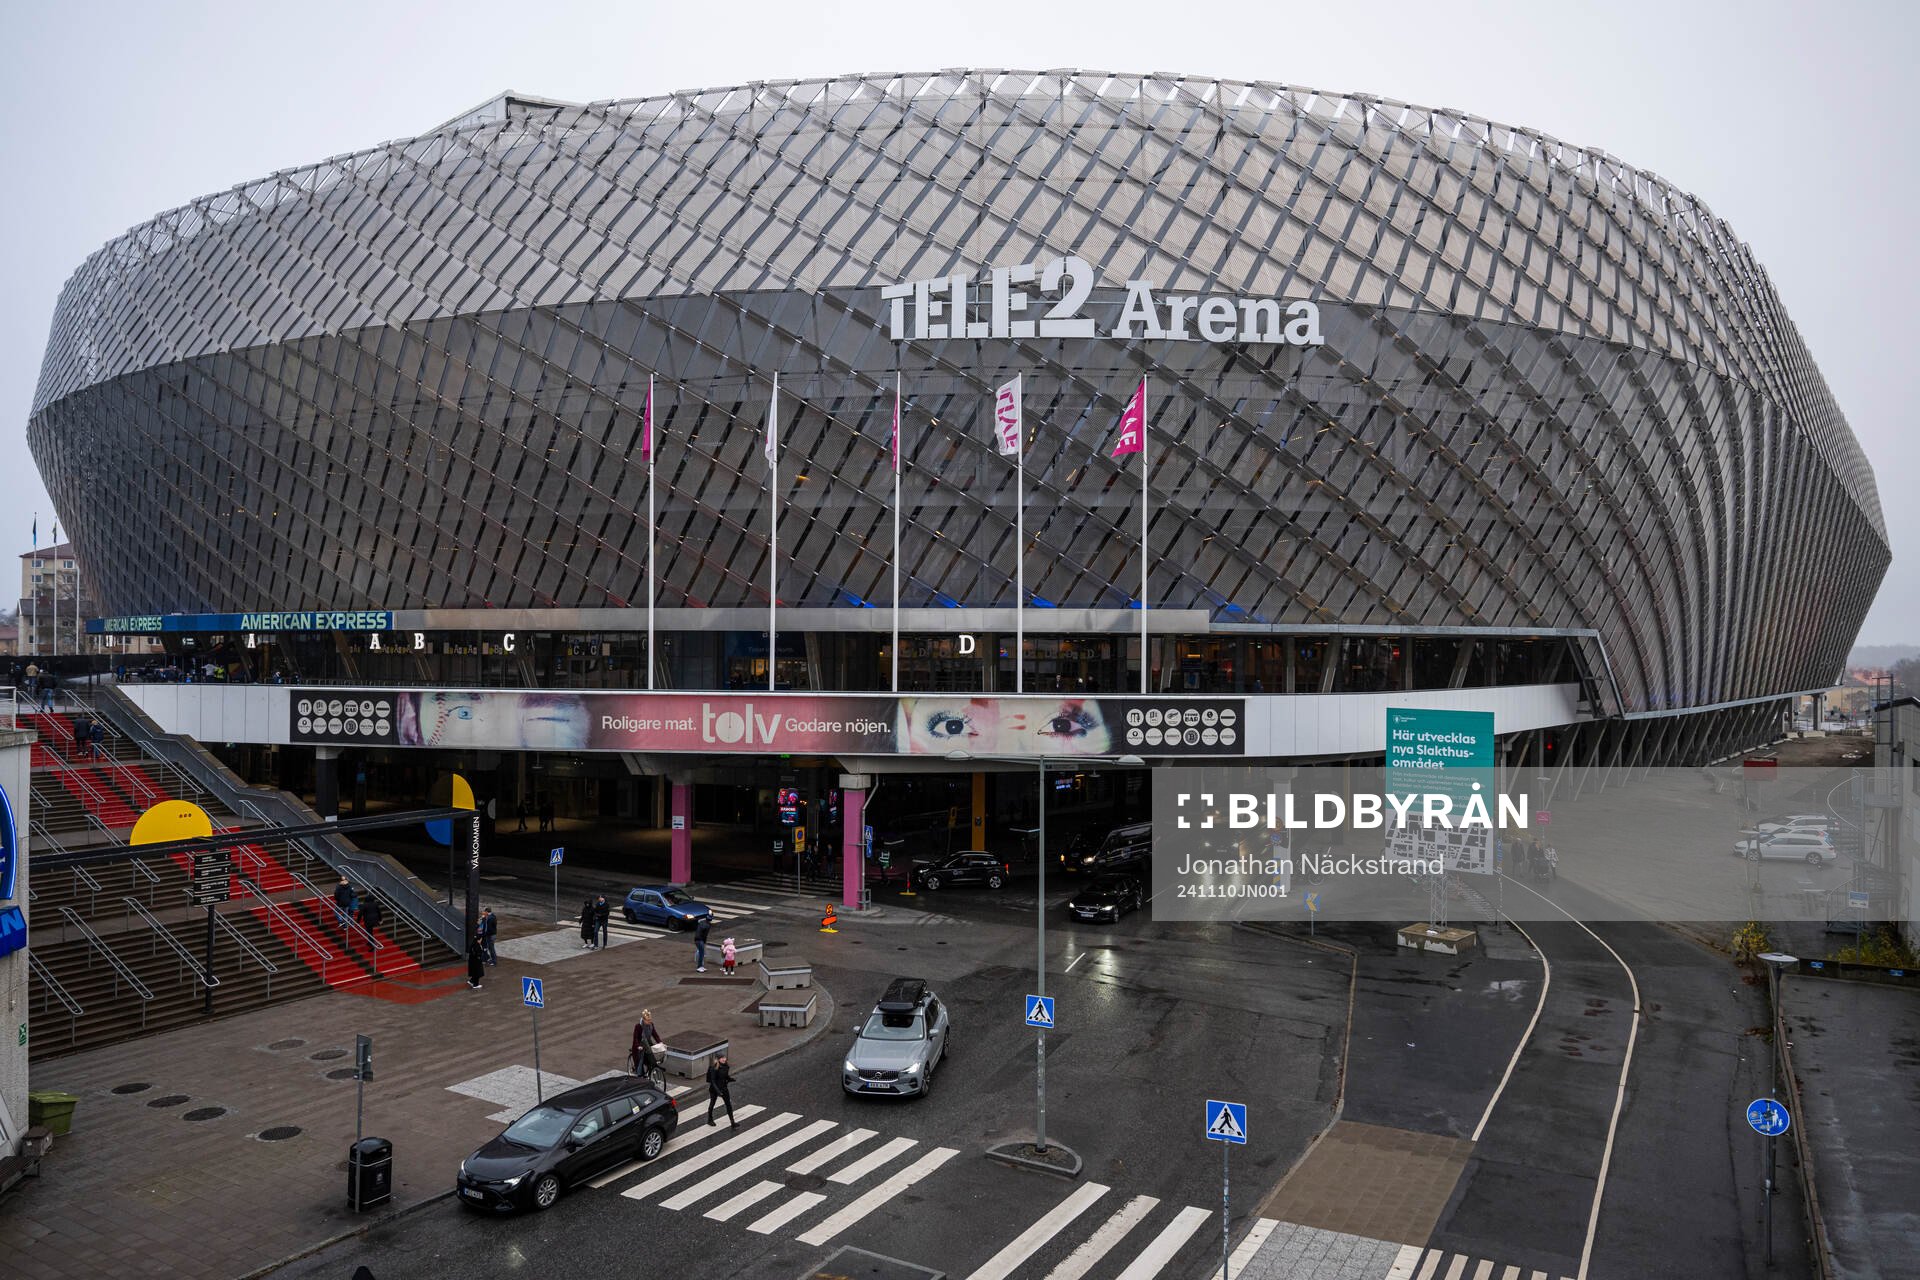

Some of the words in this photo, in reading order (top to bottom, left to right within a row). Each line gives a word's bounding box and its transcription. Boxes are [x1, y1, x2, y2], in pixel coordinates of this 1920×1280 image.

[882, 256, 1095, 339] TELE2
[1112, 280, 1325, 345] Arena
[104, 617, 129, 632] AMERICAN
[130, 616, 163, 631] EXPRESS
[240, 613, 311, 630] AMERICAN
[315, 611, 387, 630] EXPRESS
[247, 633, 256, 649] A
[369, 633, 381, 650] A
[414, 633, 425, 649] B
[503, 633, 515, 651] C
[959, 634, 976, 654] D
[601, 714, 661, 732] Roligare
[664, 717, 697, 731] mat.
[702, 703, 782, 745] tolv
[785, 718, 842, 734] Godare
[845, 716, 891, 737] nöjen.
[1392, 729, 1415, 741] Här
[1417, 731, 1476, 744] utvecklas
[1392, 745, 1414, 757] nya
[1416, 744, 1475, 758] Slakthus-
[1392, 758, 1445, 770] området
[472, 816, 480, 870] VÄLKOMMEN
